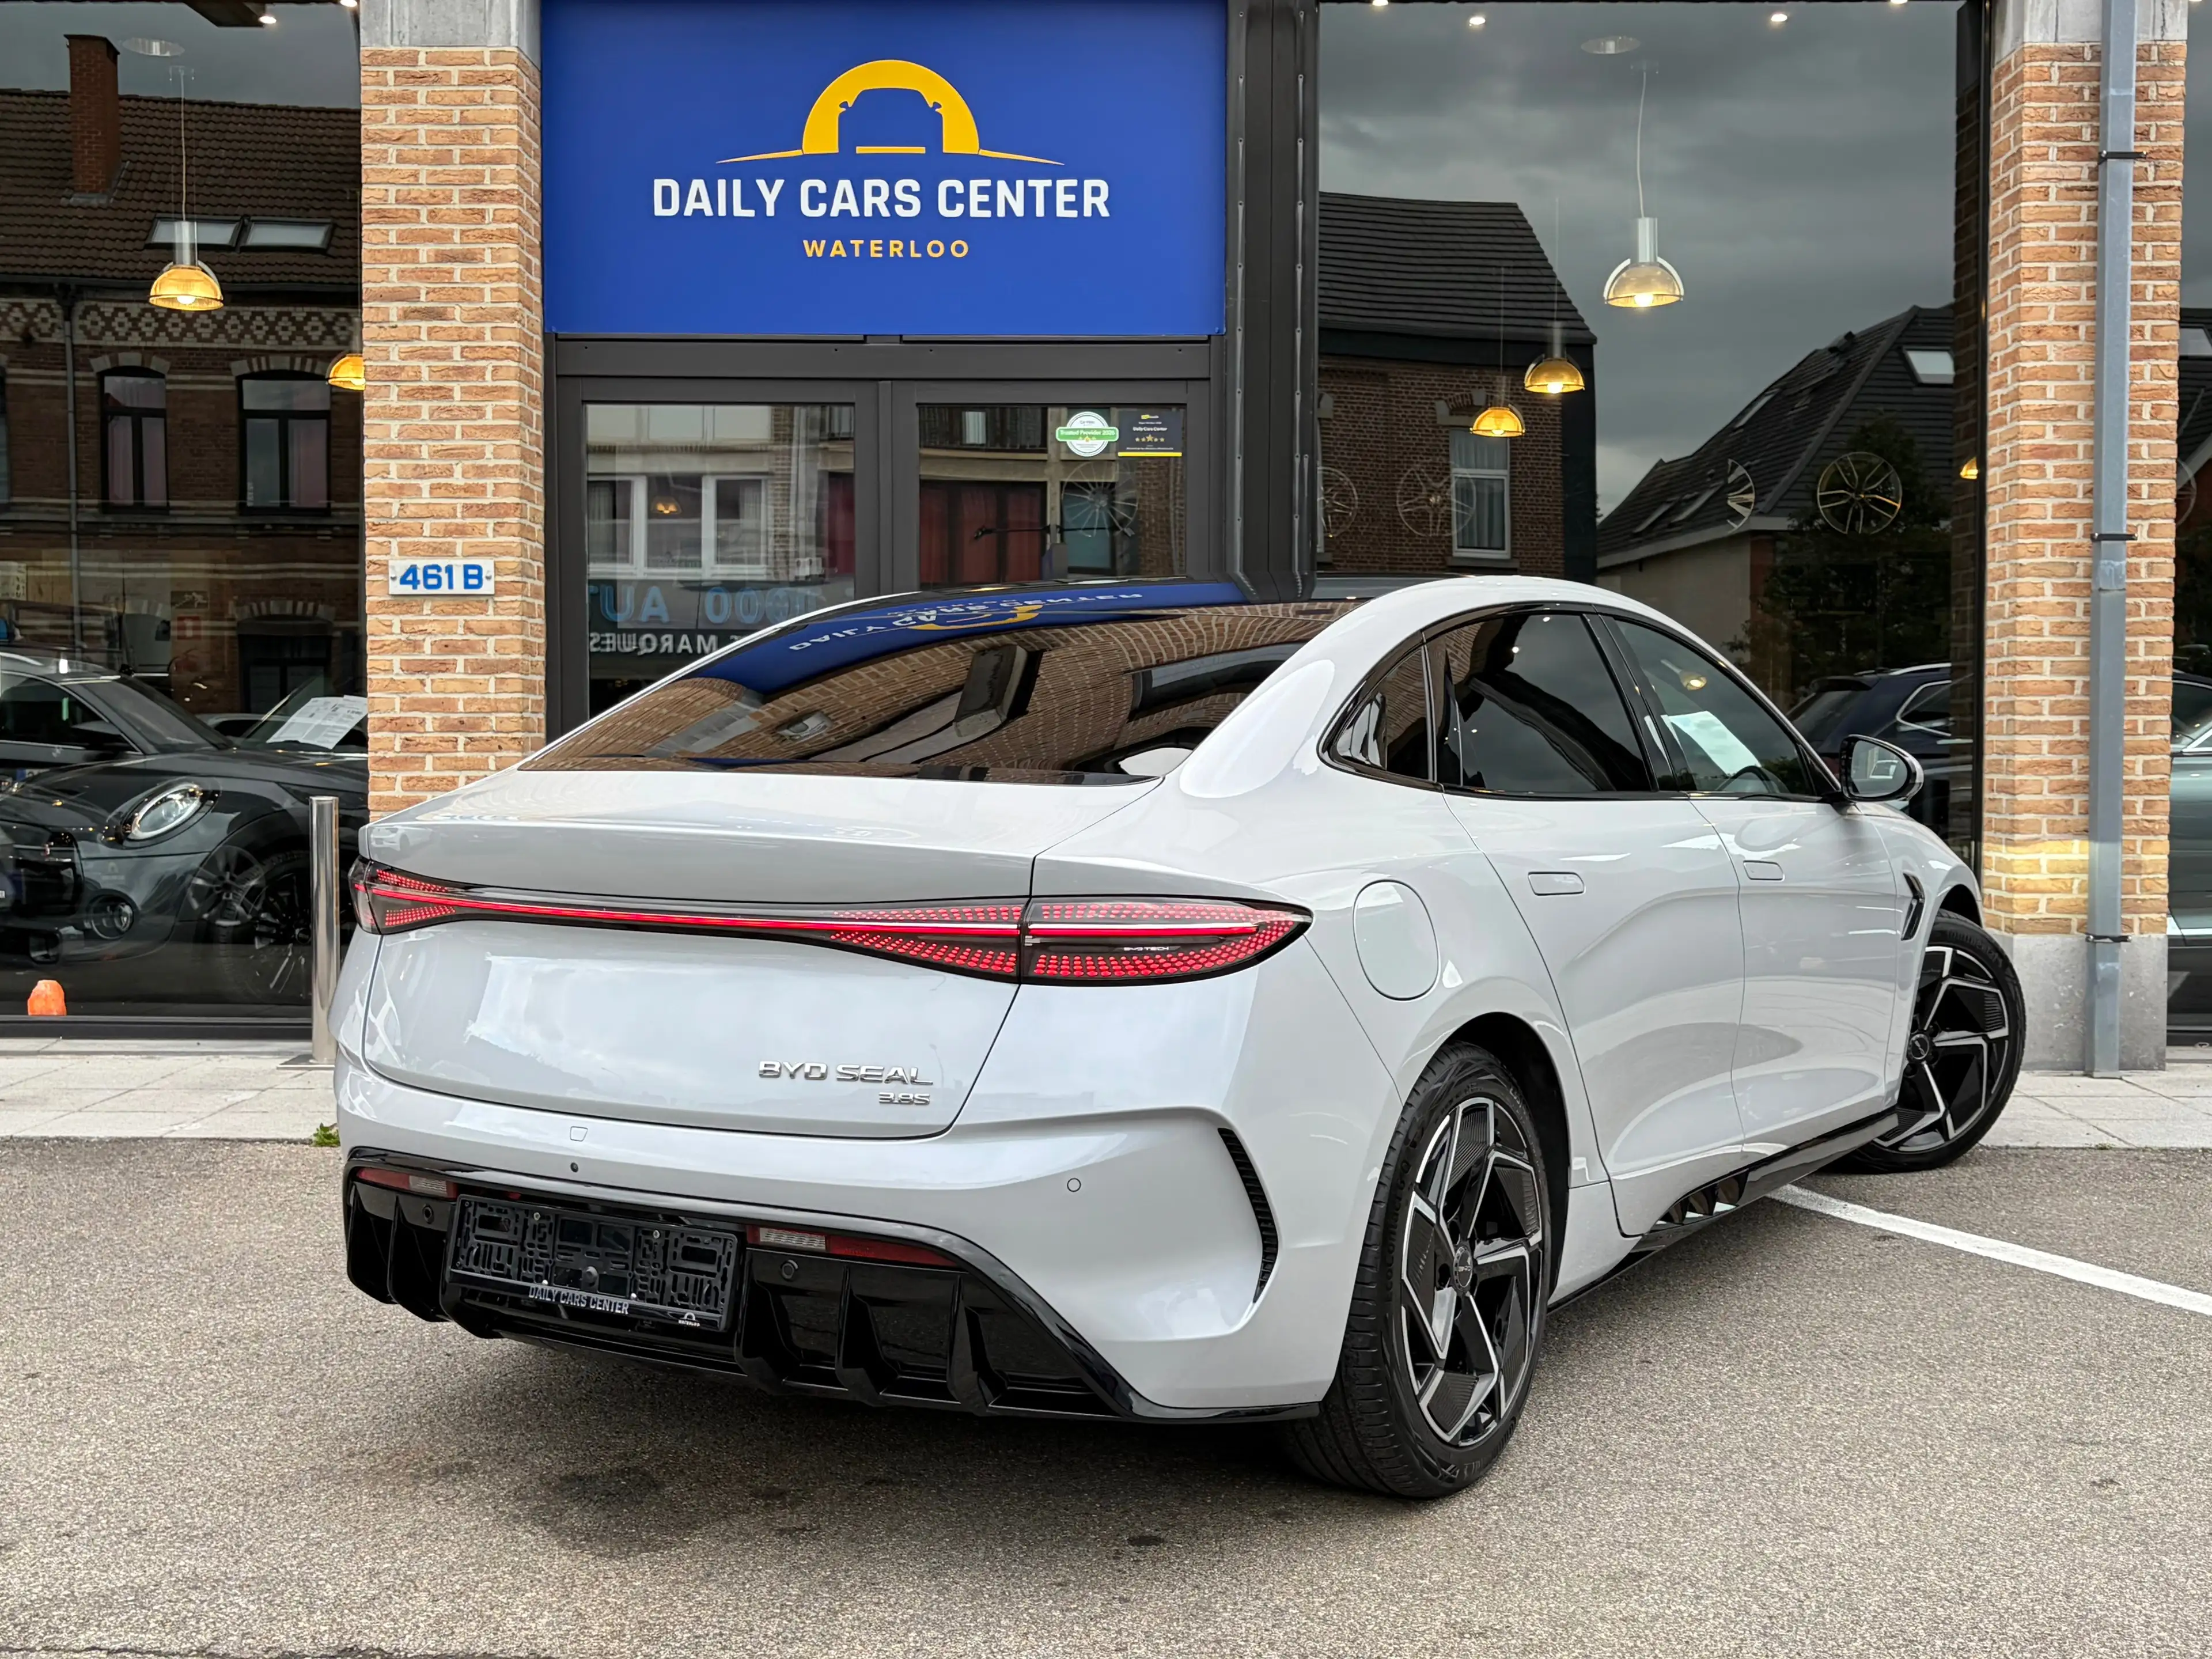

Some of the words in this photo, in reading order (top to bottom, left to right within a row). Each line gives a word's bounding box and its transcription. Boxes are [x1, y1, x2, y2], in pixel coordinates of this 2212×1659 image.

[653, 179, 785, 217] DAILY
[800, 179, 921, 217] CARS
[938, 179, 1109, 218] CENTER
[802, 240, 968, 257] WATERLOO
[399, 564, 454, 590] 461
[463, 564, 483, 590] B
[758, 1060, 828, 1081] BYD
[836, 1063, 934, 1085] SEAL
[878, 1092, 931, 1105] 3.8S
[528, 1286, 559, 1303] DAILY
[559, 1291, 587, 1308] CARS
[589, 1297, 629, 1315] CENTER
